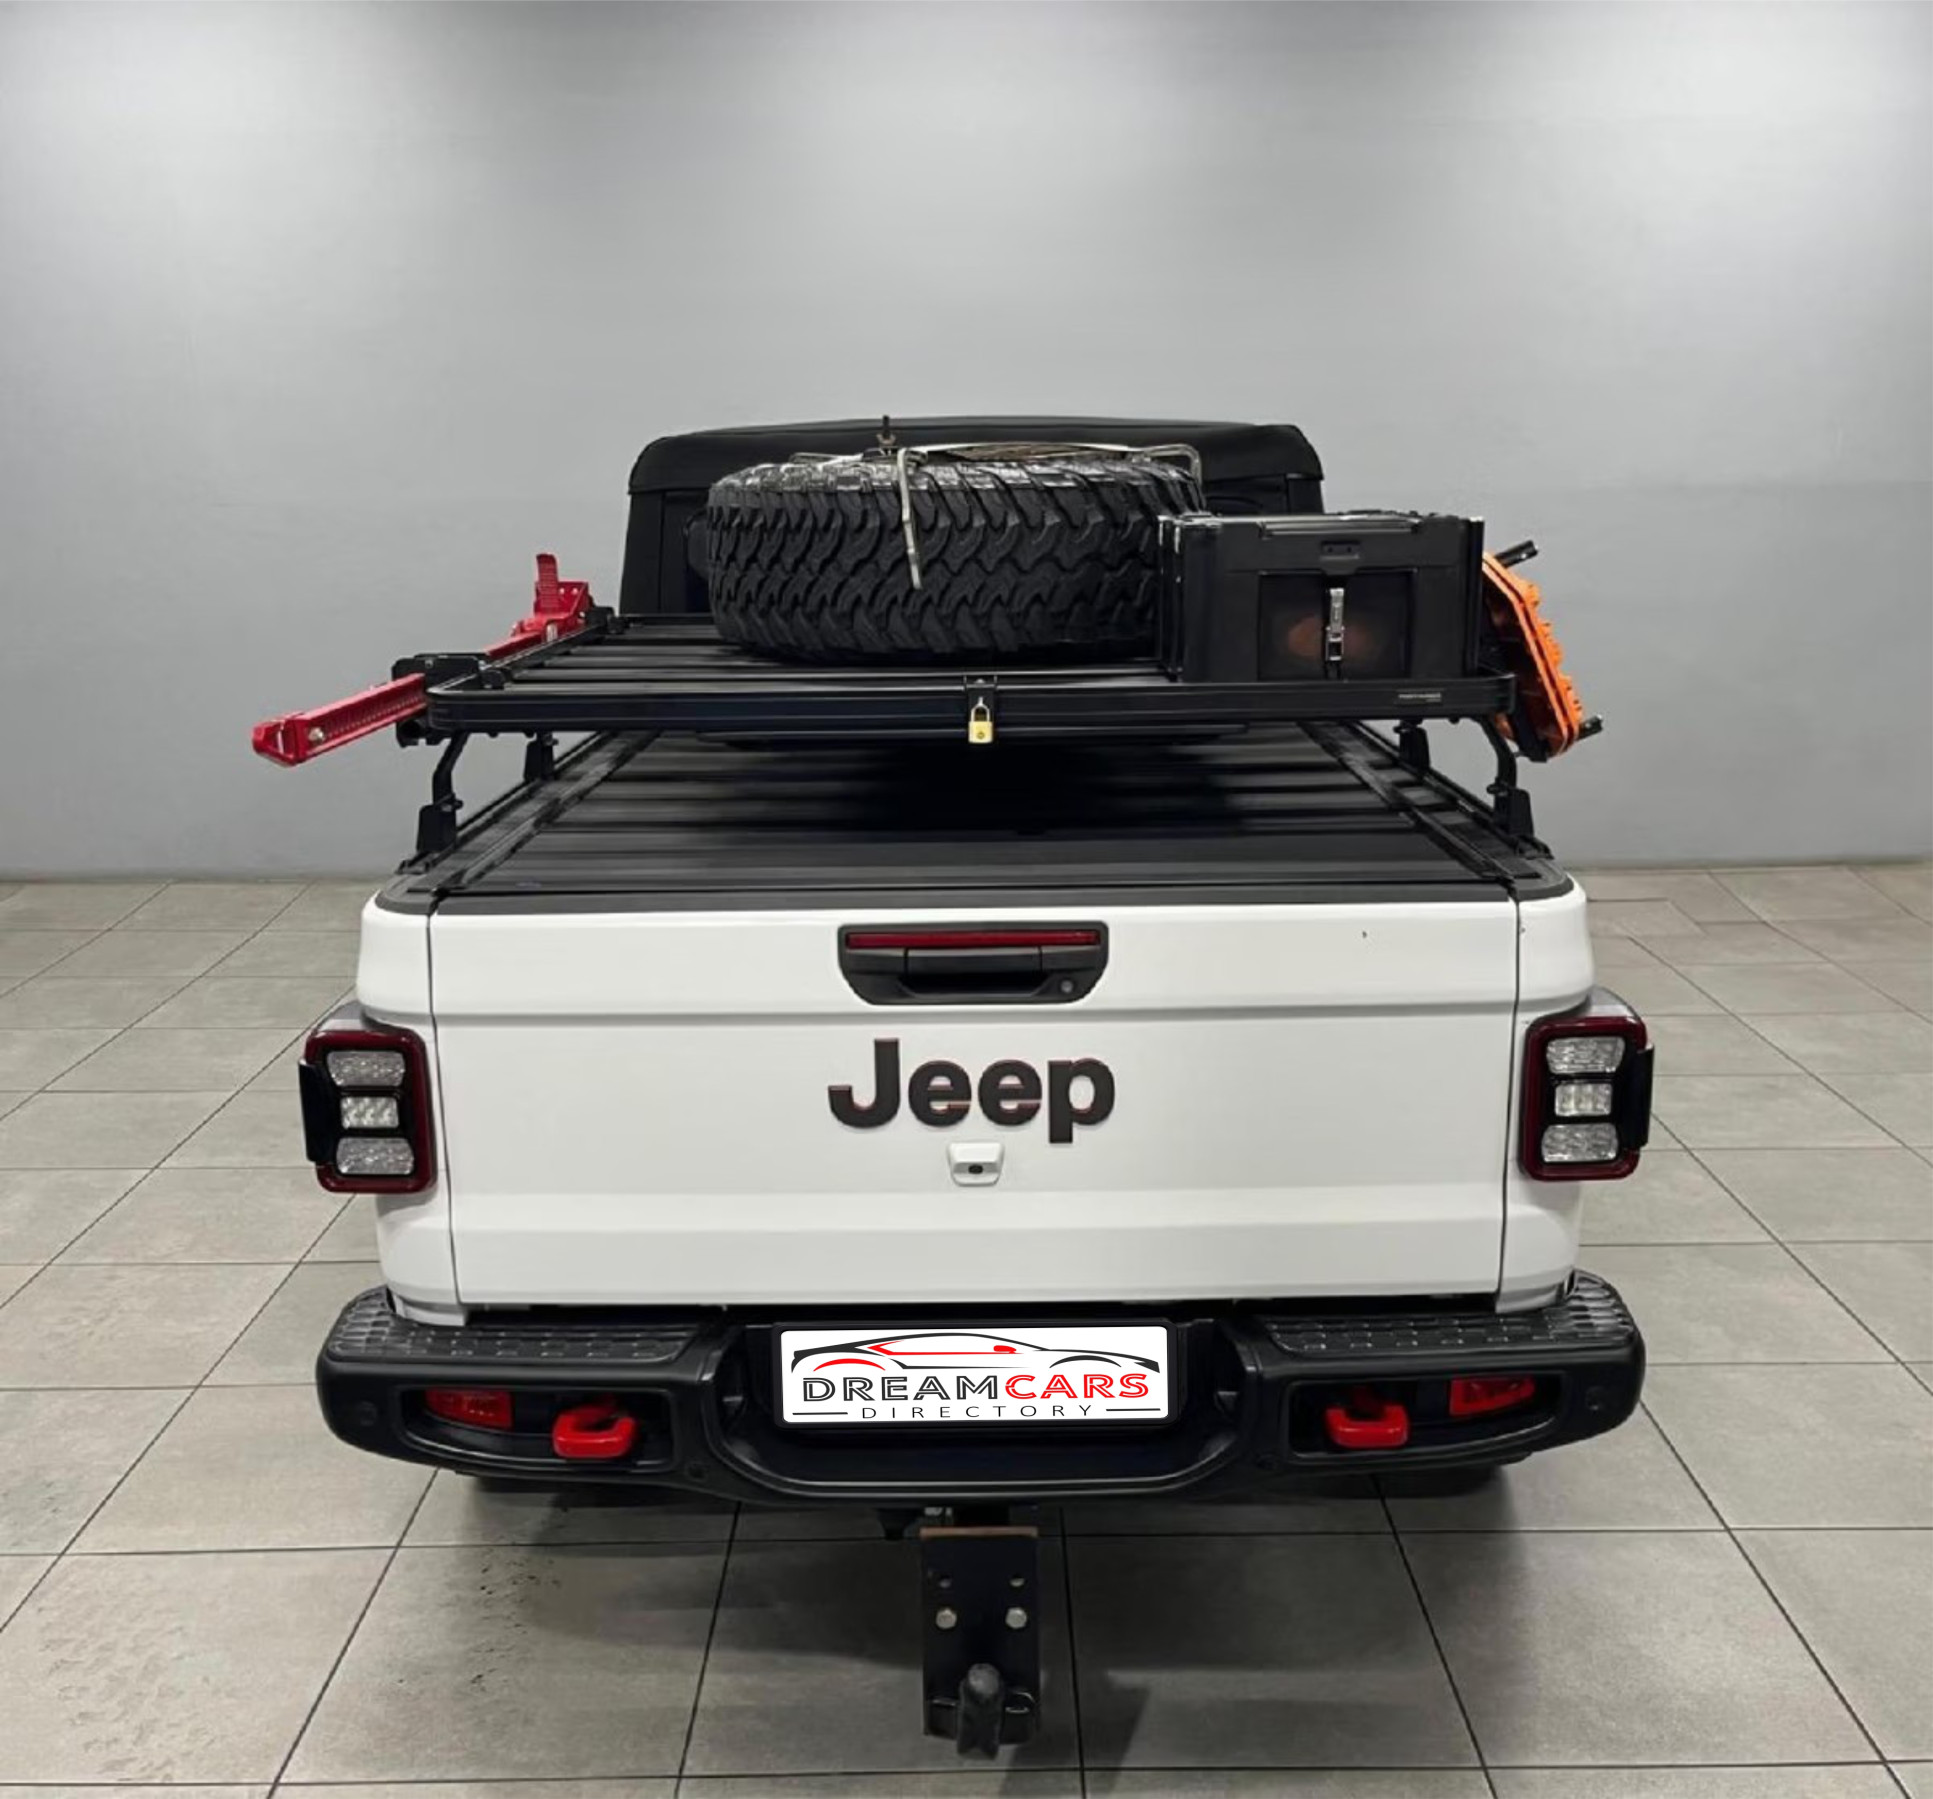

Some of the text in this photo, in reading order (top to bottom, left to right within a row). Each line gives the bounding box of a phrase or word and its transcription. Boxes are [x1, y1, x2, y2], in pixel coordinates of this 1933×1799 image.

[828, 1038, 1115, 1143] Jeep
[803, 1373, 1149, 1402] DREAMCARS
[862, 1405, 1092, 1419] DIRECTORY
